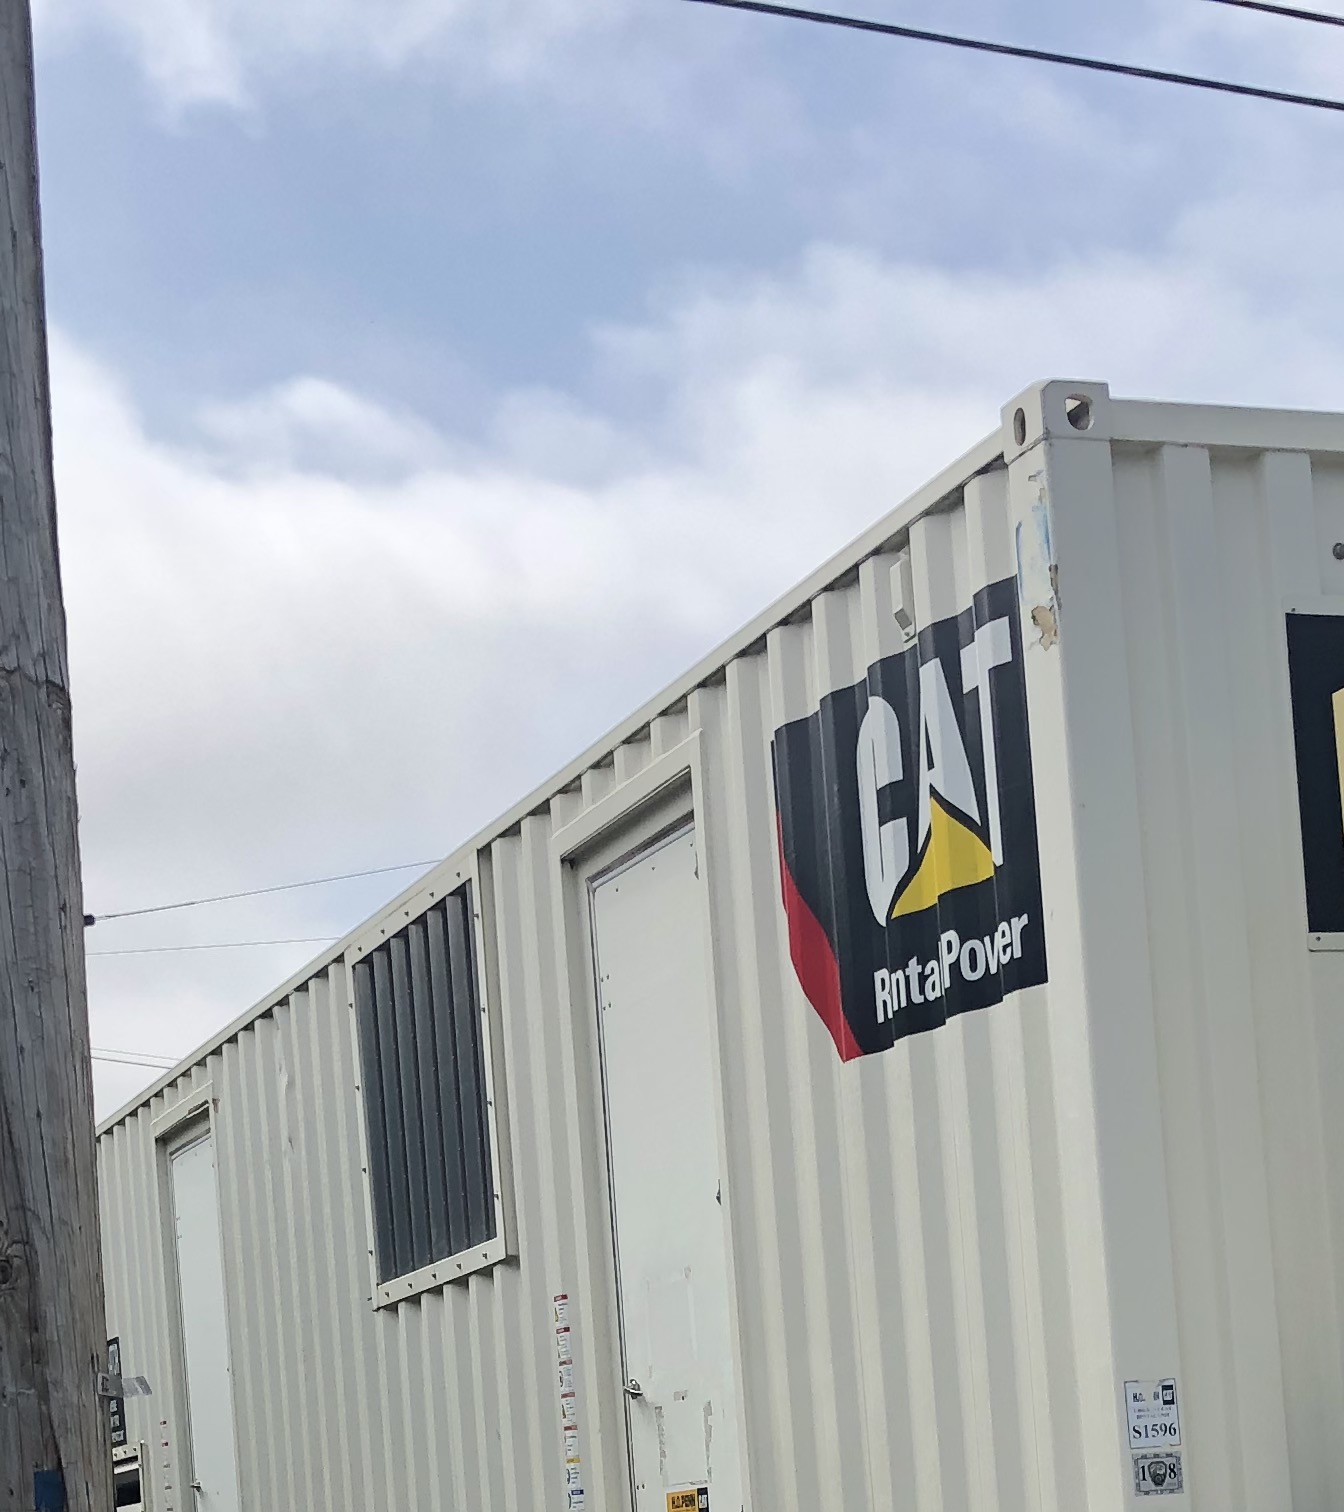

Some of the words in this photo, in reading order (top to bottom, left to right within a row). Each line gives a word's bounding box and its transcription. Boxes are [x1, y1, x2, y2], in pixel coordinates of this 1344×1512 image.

[856, 615, 1013, 928] CAT
[1132, 1422, 1177, 1439] S1596
[1140, 1465, 1148, 1481] 1
[1168, 1463, 1177, 1479] 8
